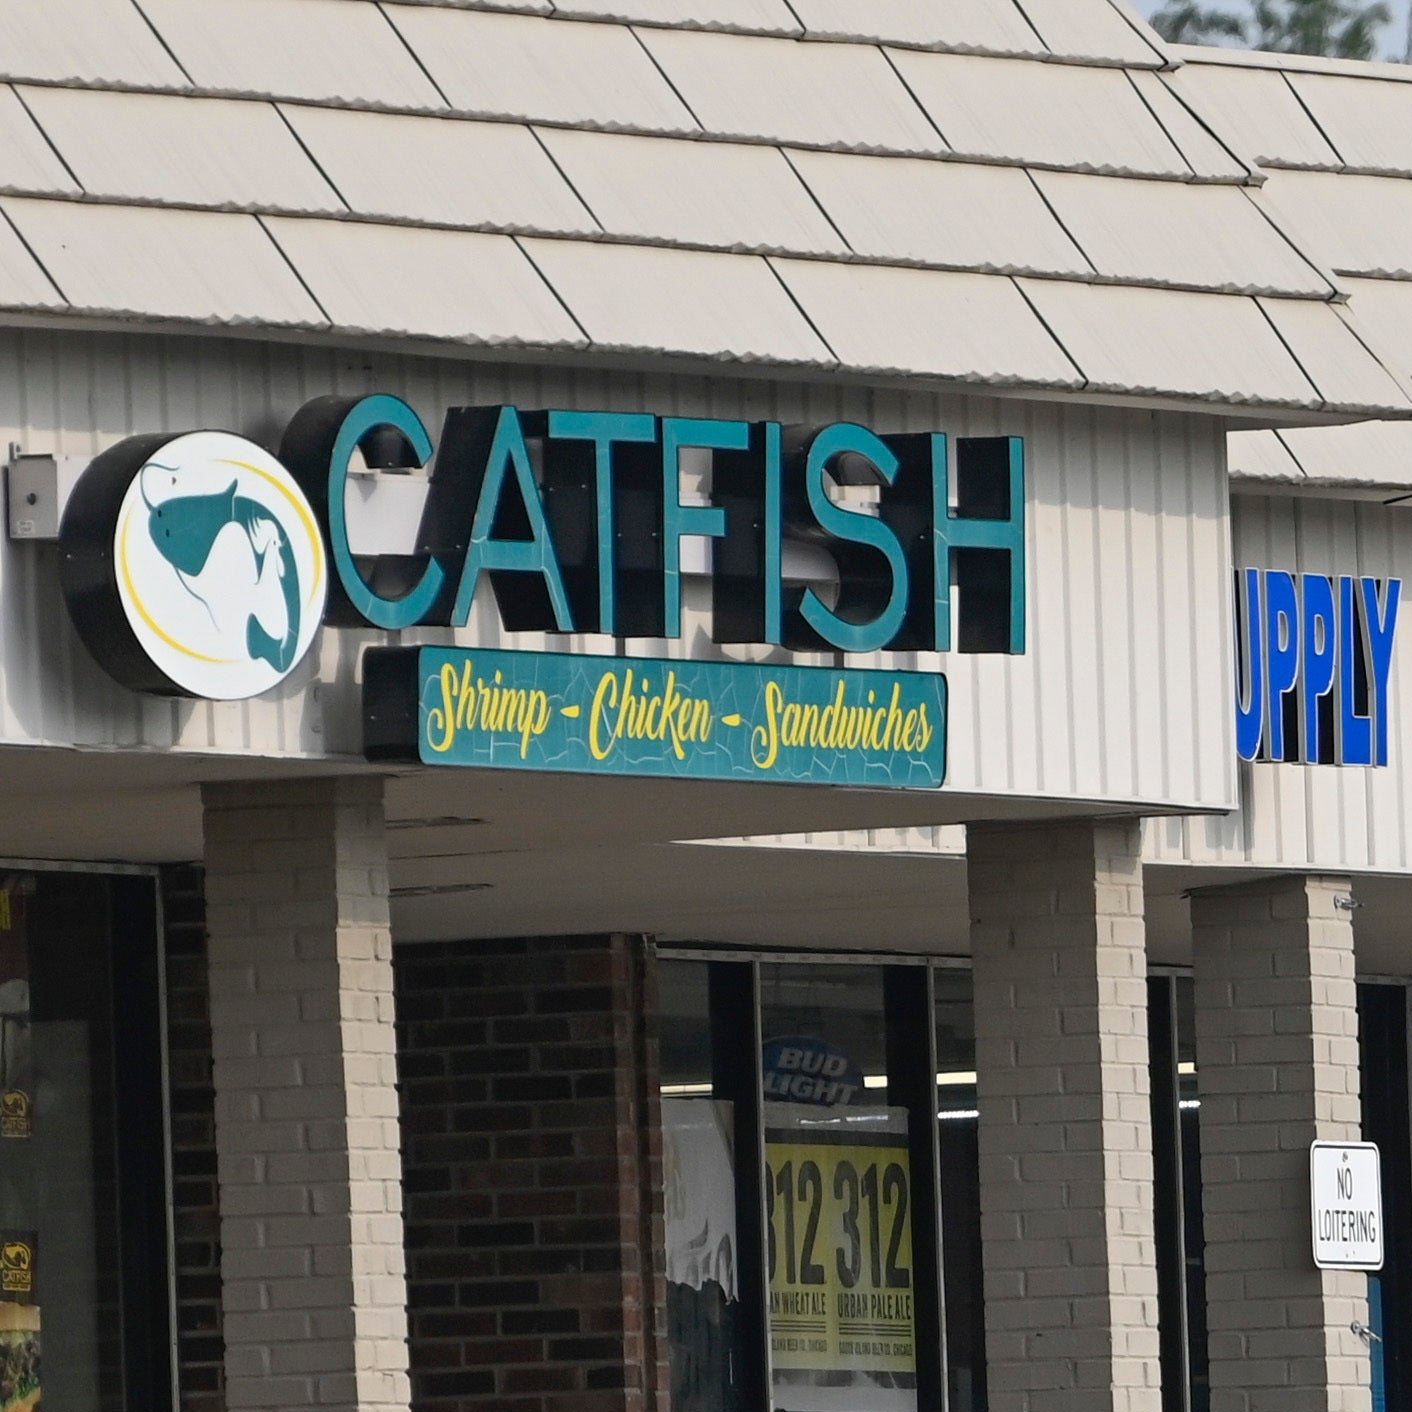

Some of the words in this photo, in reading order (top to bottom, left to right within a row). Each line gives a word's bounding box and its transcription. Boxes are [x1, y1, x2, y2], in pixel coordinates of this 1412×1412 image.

[326, 392, 1026, 656] CATFISH
[1234, 566, 1402, 767] UPPLY
[426, 658, 551, 759] Shrimp
[589, 669, 713, 761] Chicken
[750, 679, 933, 769] Sandwiches
[777, 1046, 848, 1078] BUD
[763, 1071, 858, 1105] LIGHT
[1336, 1167, 1353, 1200] NO
[833, 1161, 910, 1289] 312
[1318, 1210, 1376, 1243] LOITERING
[811, 1292, 826, 1315] ALE
[837, 1293, 868, 1318] URBAN
[871, 1294, 892, 1319] PALE
[894, 1295, 911, 1320] ALE
